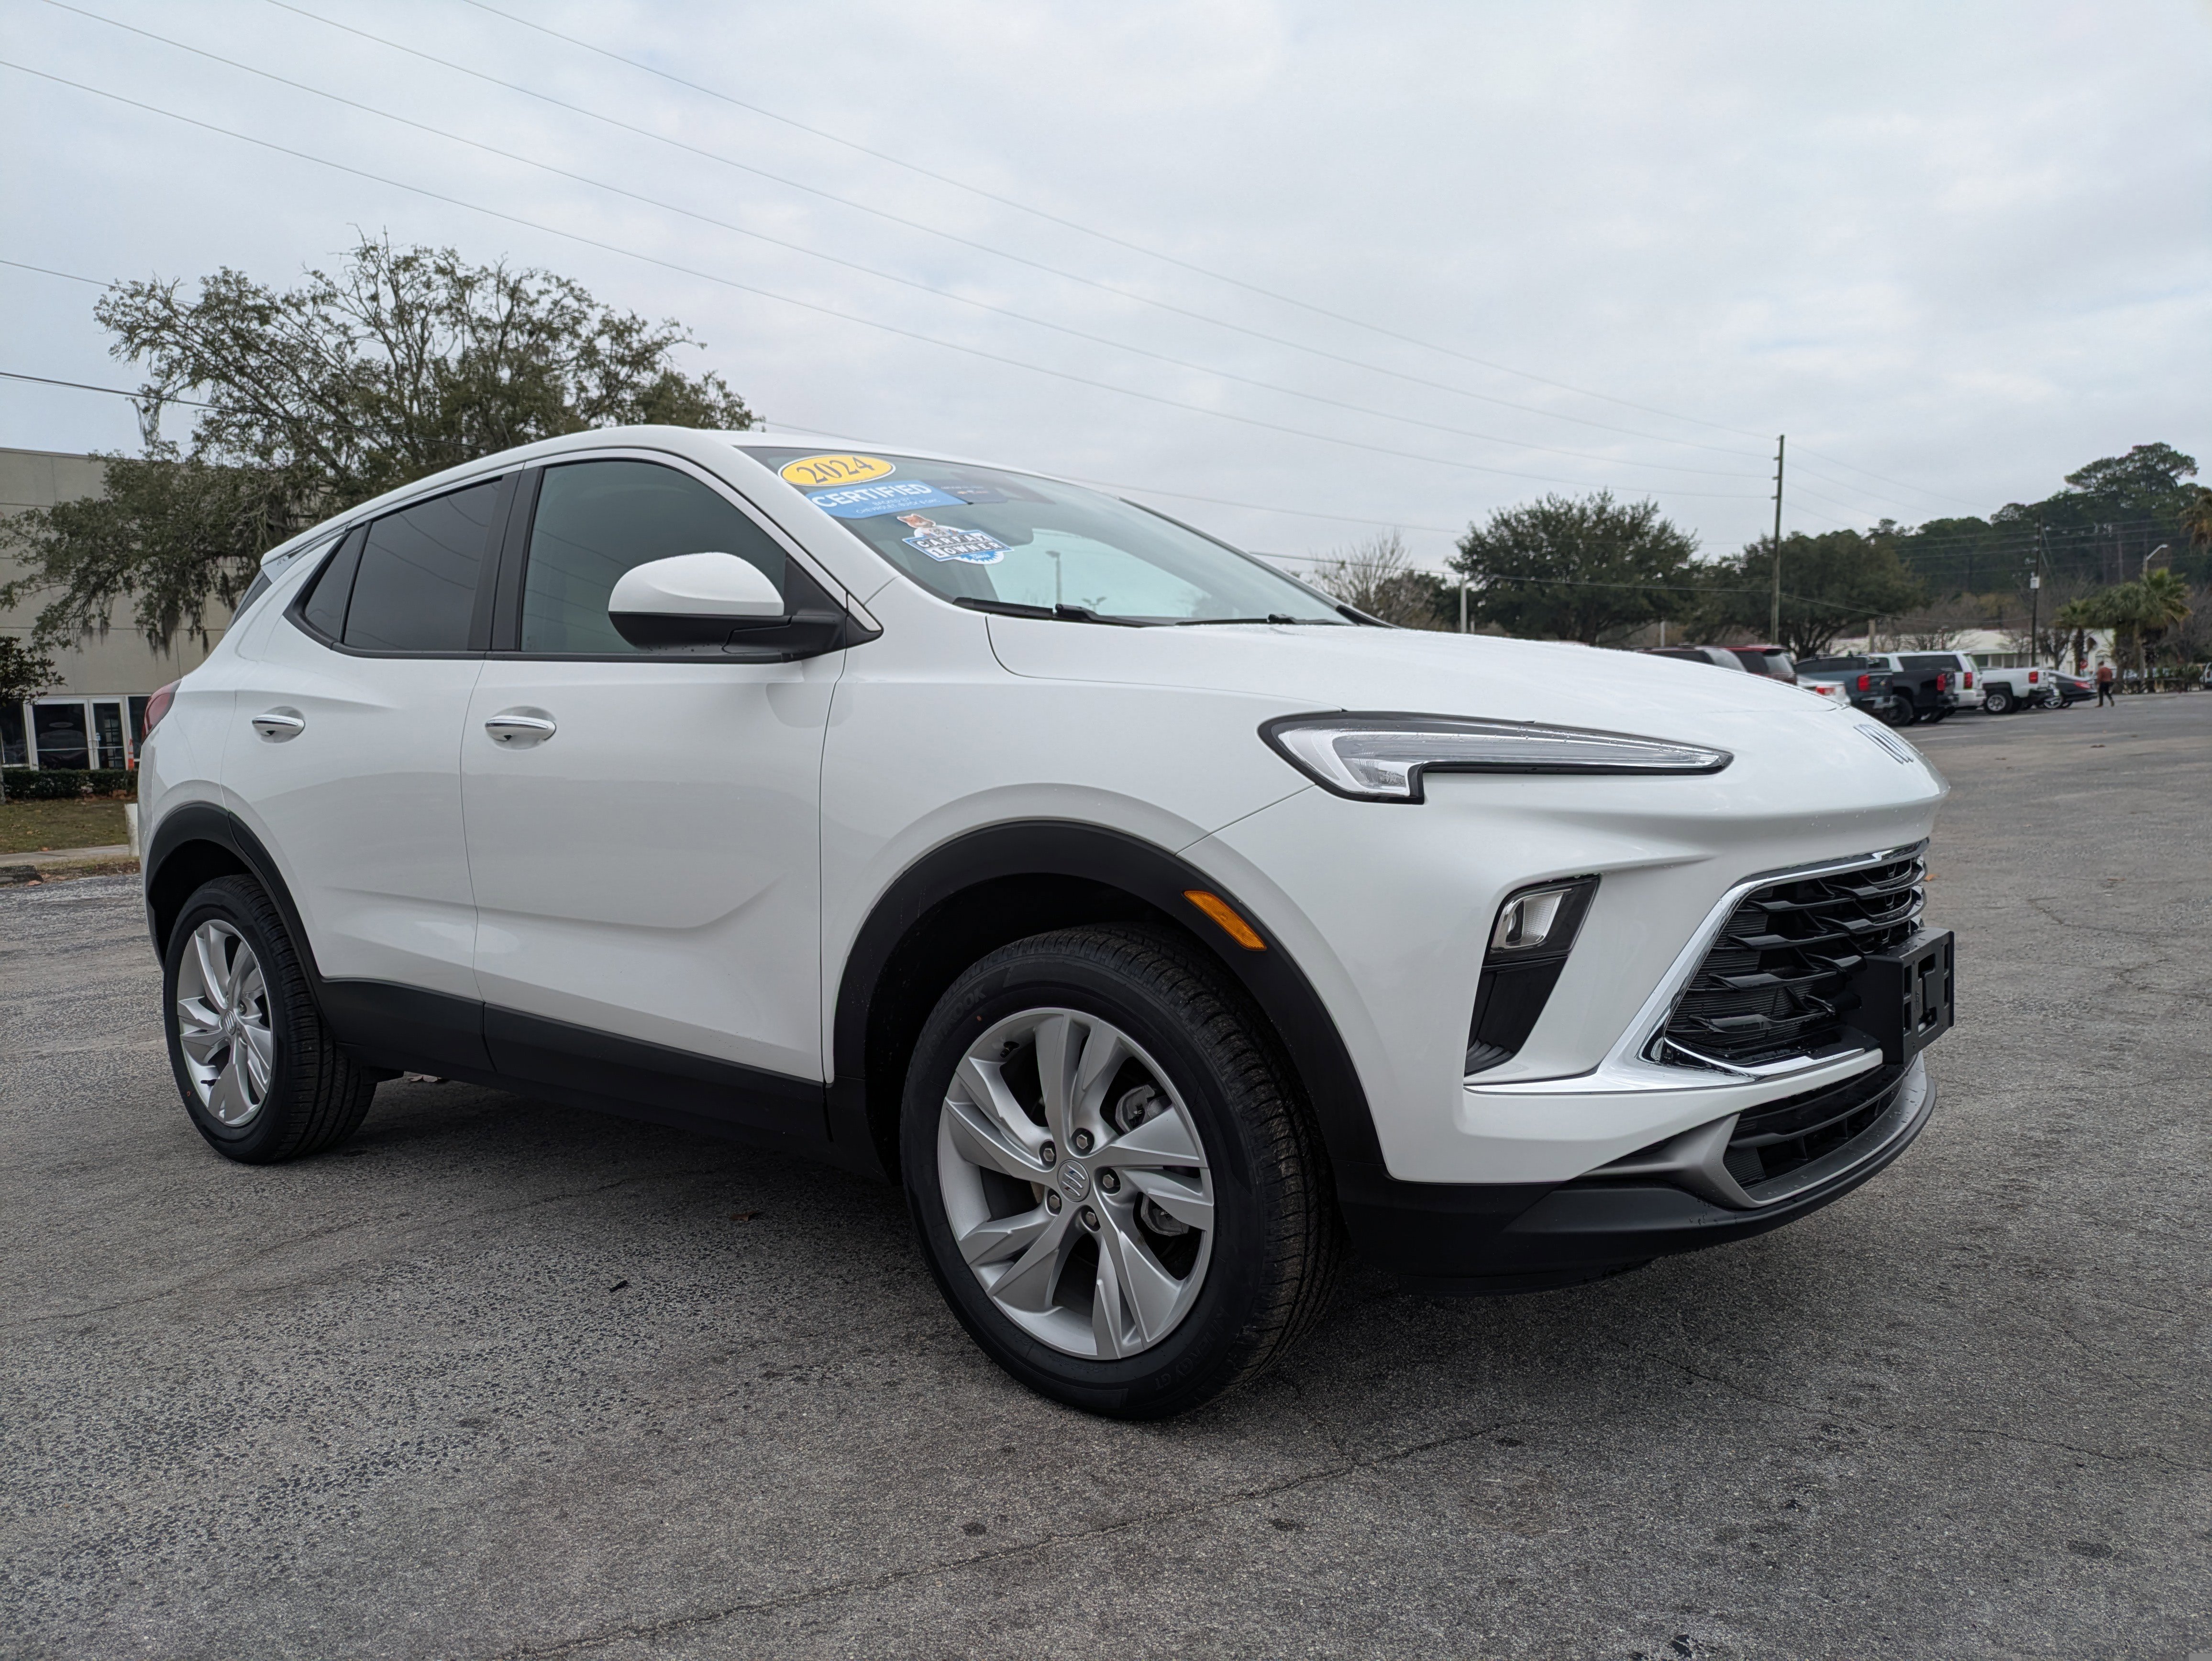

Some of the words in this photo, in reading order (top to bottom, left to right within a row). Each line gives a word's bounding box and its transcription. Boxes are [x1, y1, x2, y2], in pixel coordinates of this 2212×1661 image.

[796, 456, 875, 483] 2024
[812, 484, 932, 507] CERTIFIED
[917, 534, 990, 548] CARFAX
